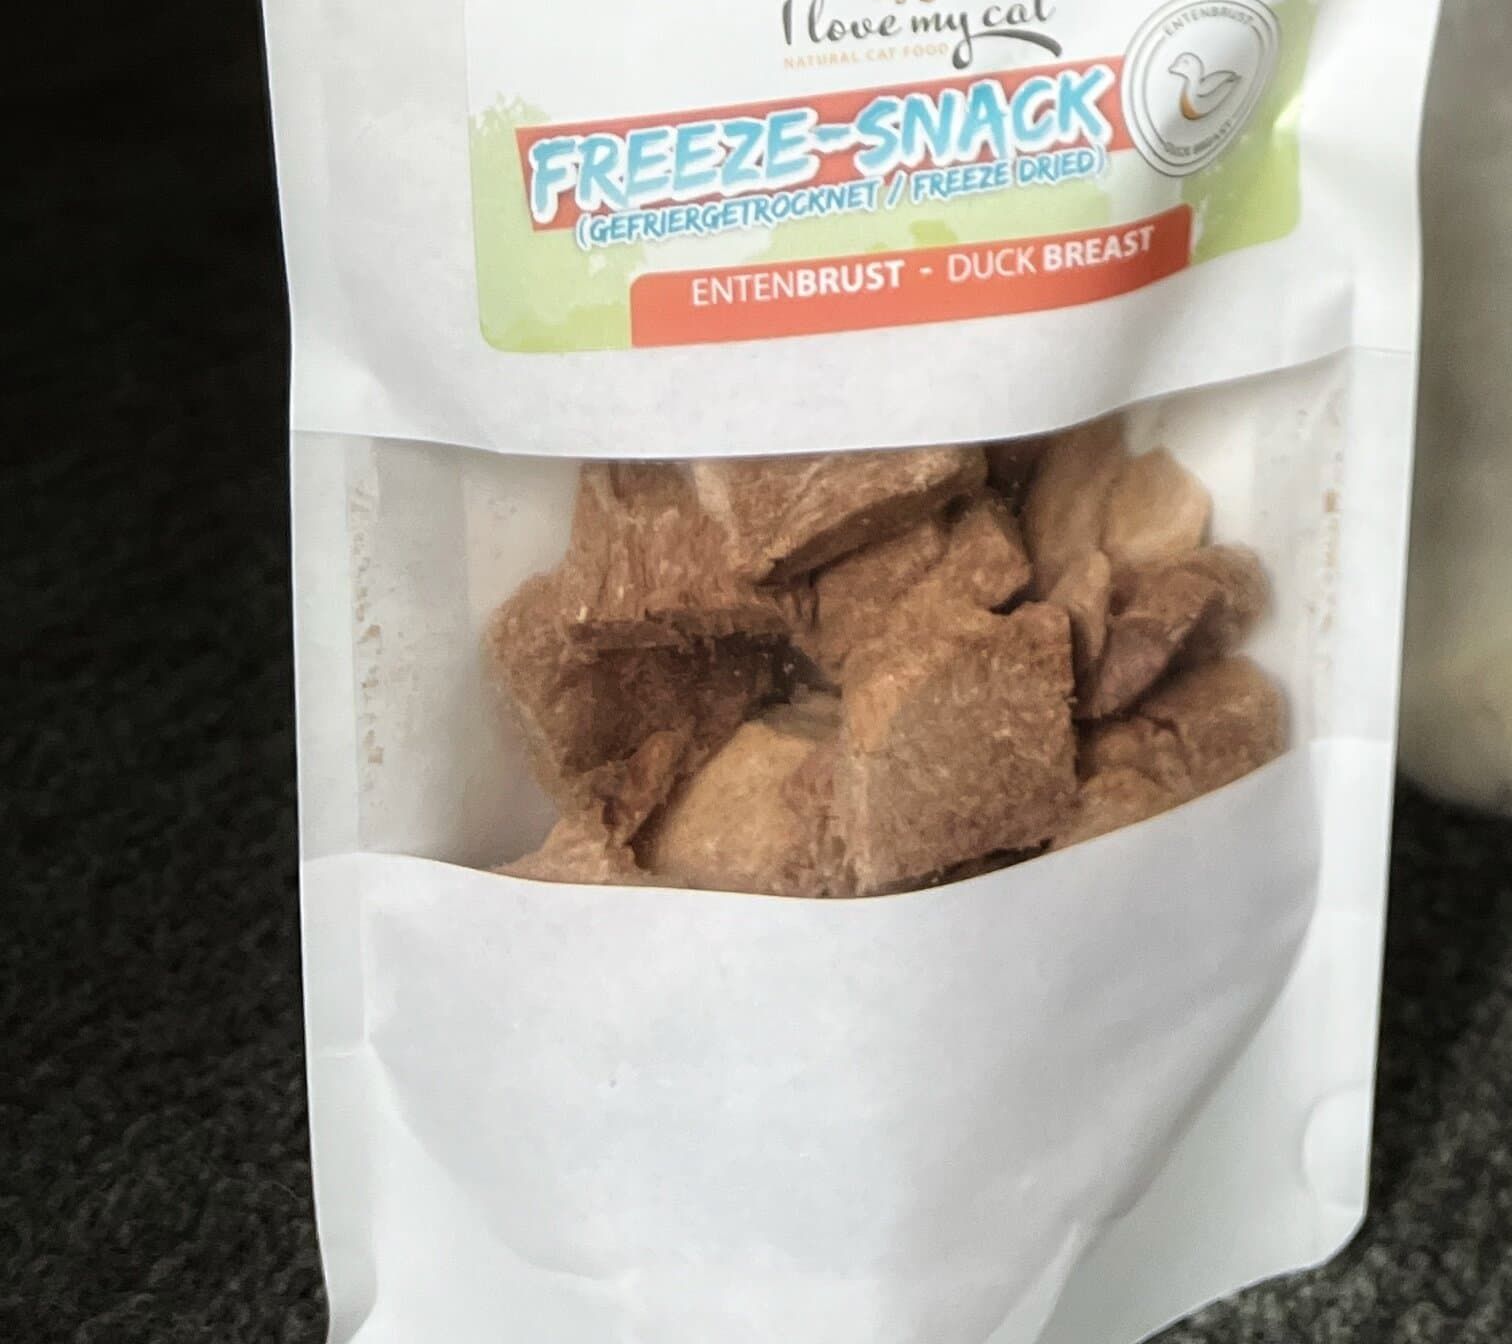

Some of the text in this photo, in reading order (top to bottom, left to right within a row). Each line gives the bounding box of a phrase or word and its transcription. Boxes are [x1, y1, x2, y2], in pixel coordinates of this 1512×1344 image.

[784, 42, 949, 70] NATURAL CAT FOOD
[1163, 6, 1254, 37] ENTENBRUST
[529, 64, 1108, 220] FREEZE-SNACK
[577, 143, 1107, 247] (GEFRIERGETROCKNET / FREEZE DRIED)
[692, 260, 904, 307] ENTENBRUST
[947, 248, 1037, 283] DUCK
[1042, 225, 1155, 272] BREAST
